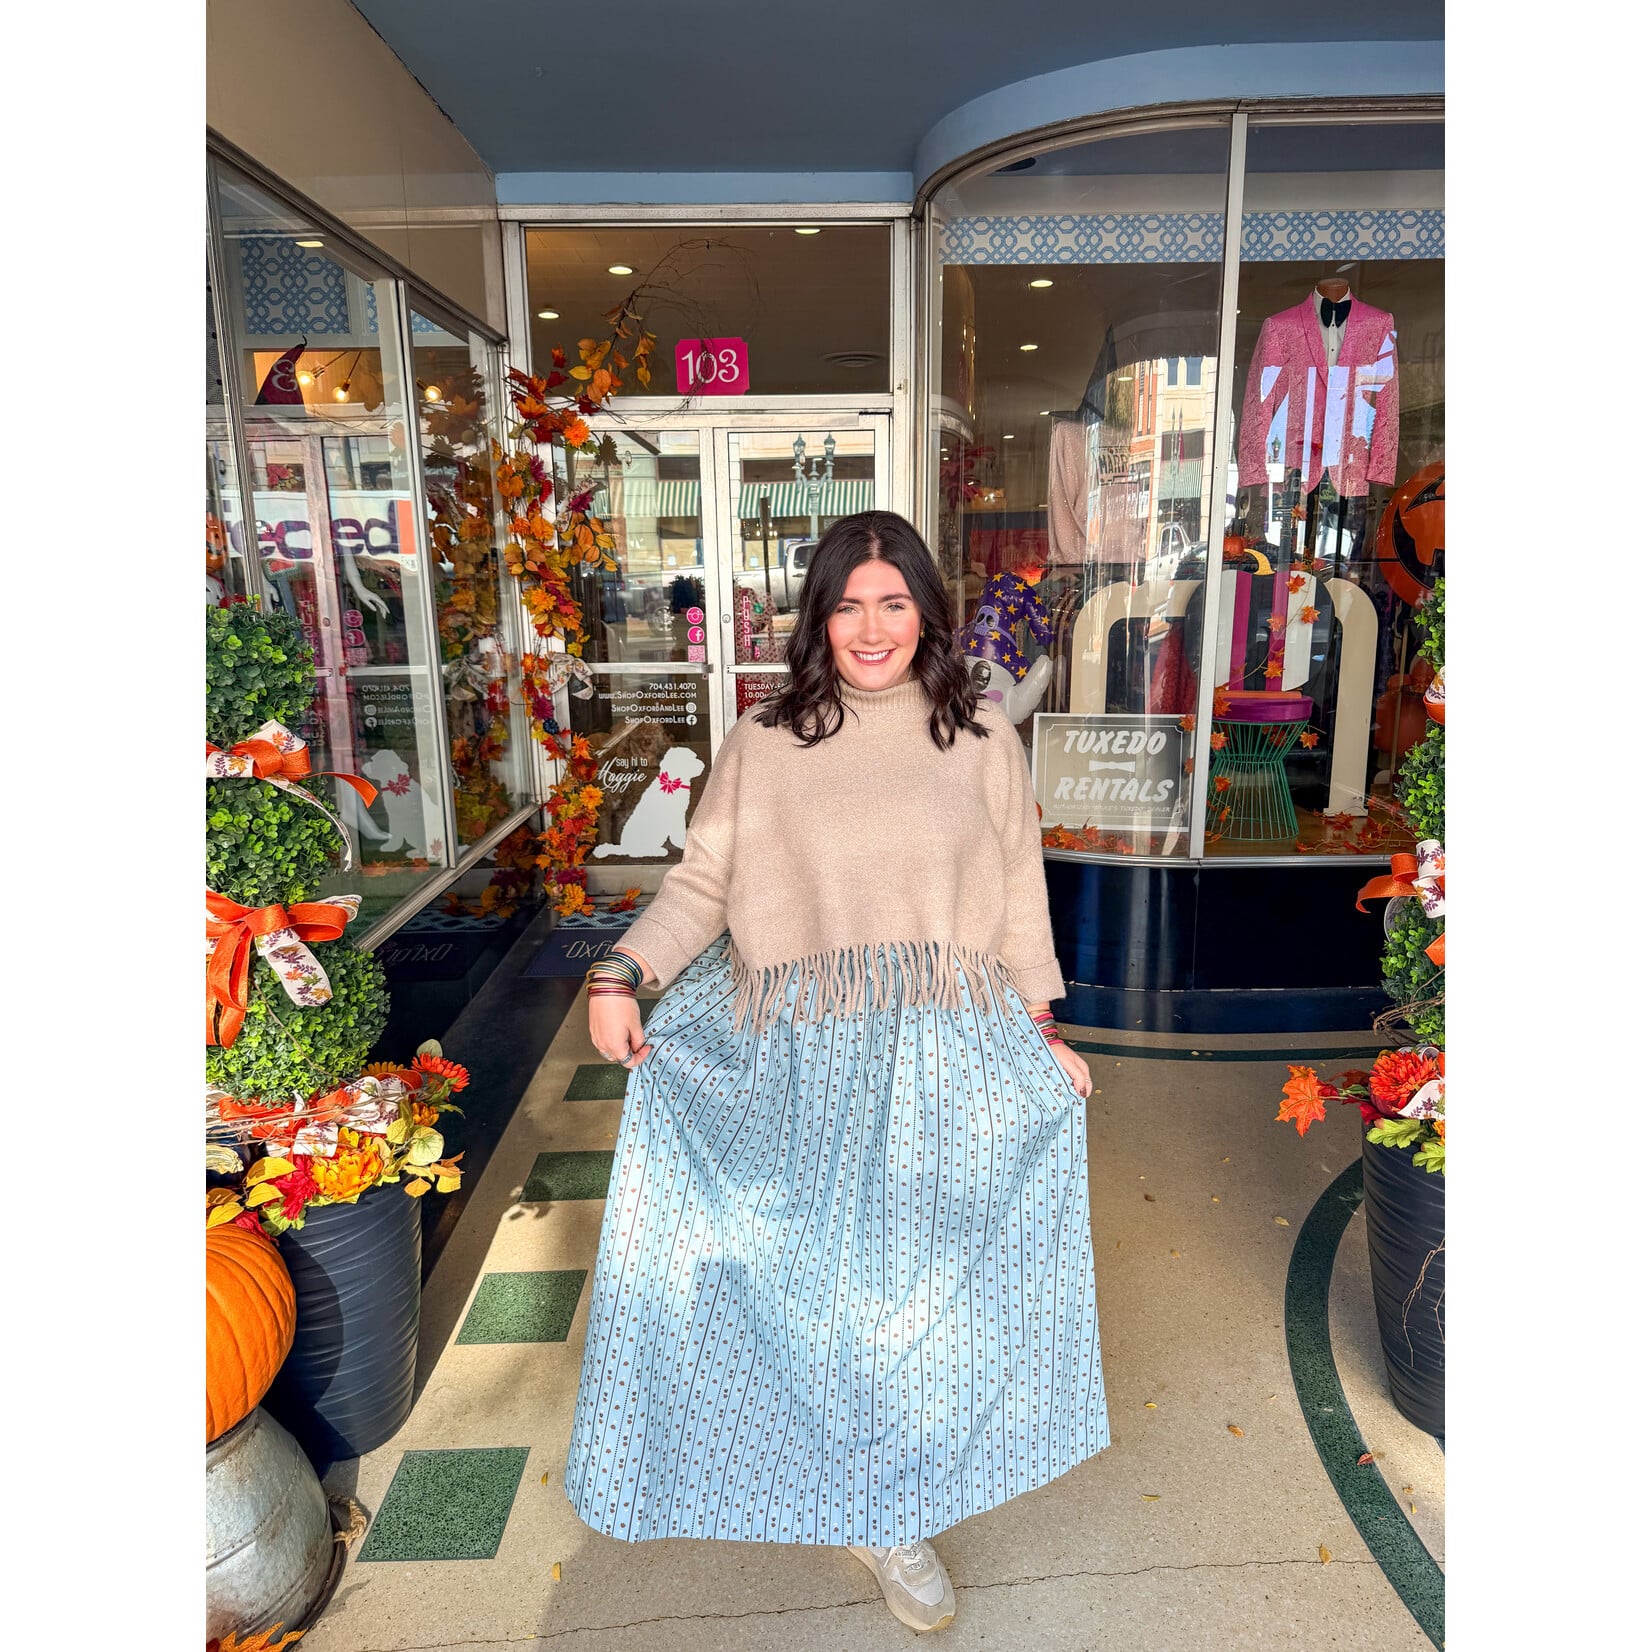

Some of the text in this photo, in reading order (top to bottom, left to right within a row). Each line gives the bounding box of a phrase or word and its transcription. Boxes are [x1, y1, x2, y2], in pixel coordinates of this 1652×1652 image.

[681, 348, 740, 385] 103
[742, 595, 752, 647] PUSH
[649, 682, 697, 690] 704.431.4070
[1063, 730, 1167, 755] TUXEDO
[597, 756, 648, 793] Maggie
[615, 756, 648, 769] say hi to
[1053, 776, 1175, 803] RENTALS
